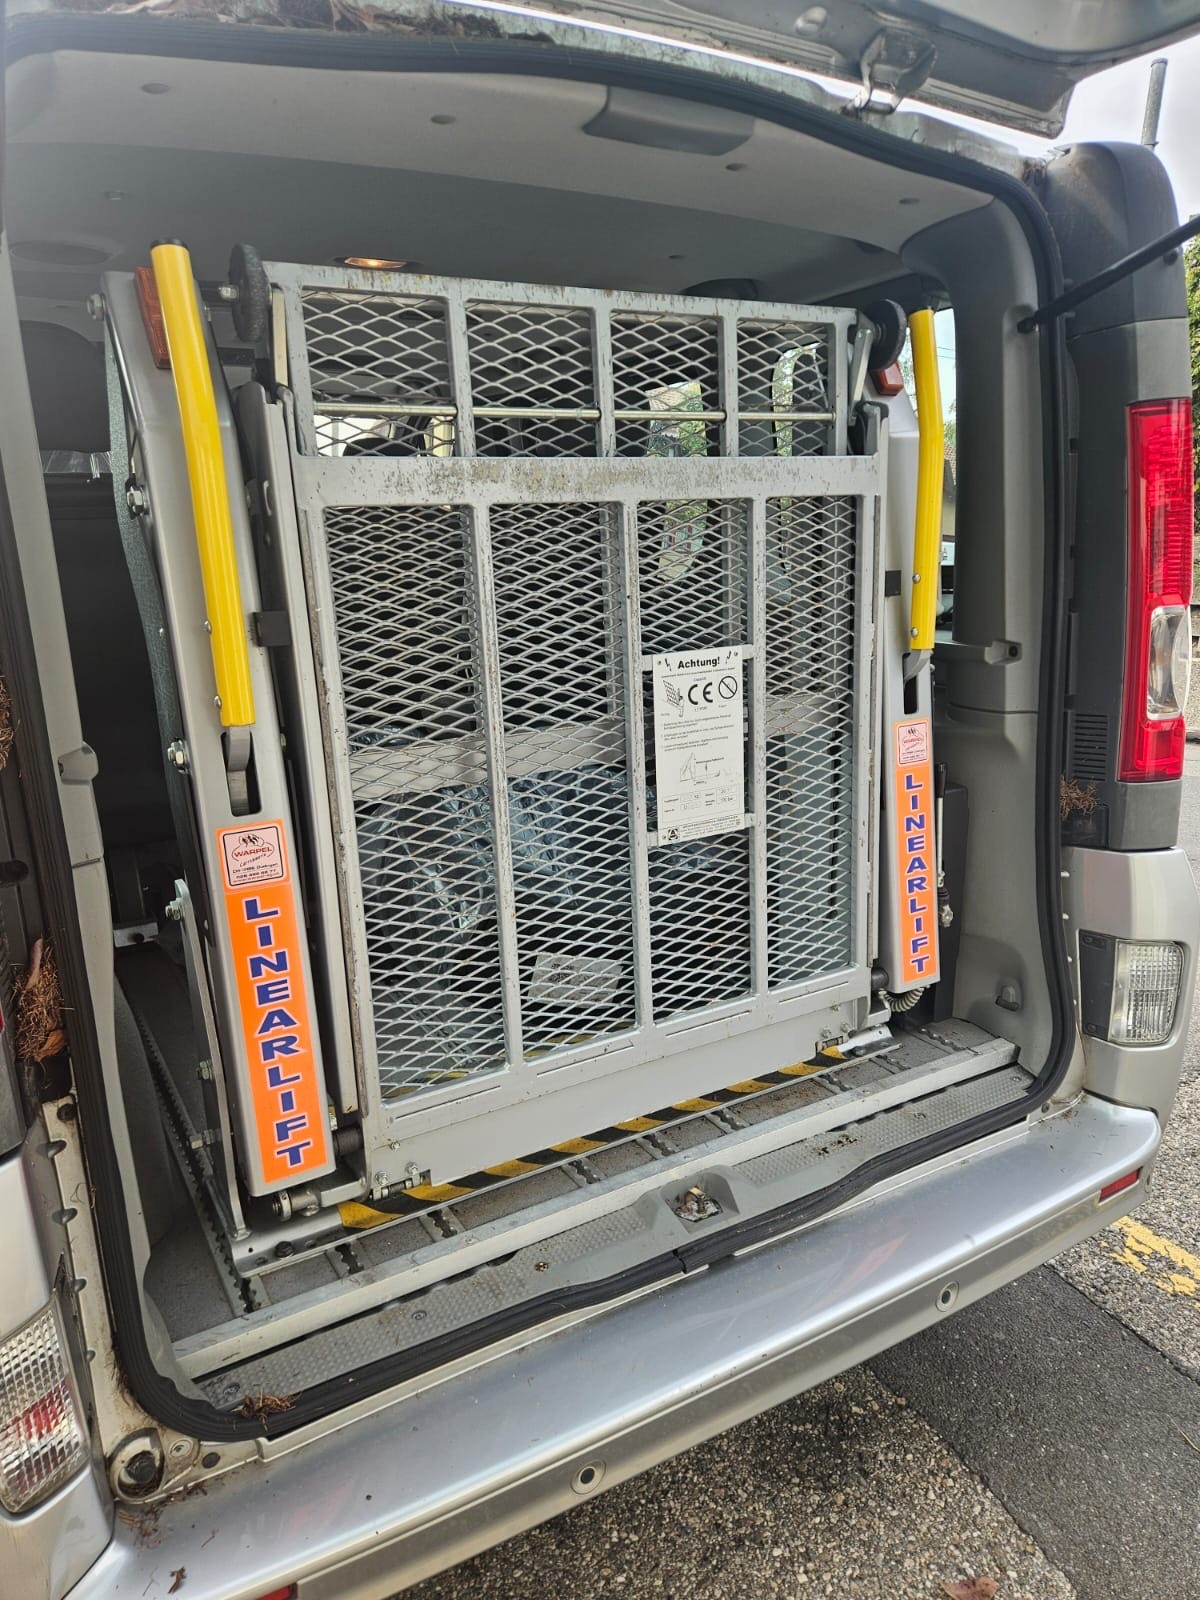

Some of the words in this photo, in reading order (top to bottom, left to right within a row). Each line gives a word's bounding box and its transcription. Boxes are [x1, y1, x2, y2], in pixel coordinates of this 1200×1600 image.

[677, 656, 720, 669] Achtung!
[688, 681, 713, 705] CE
[234, 846, 273, 857] WARPEL
[905, 774, 929, 973] LINEARLIFT
[244, 898, 312, 1167] LINEARLIFT
